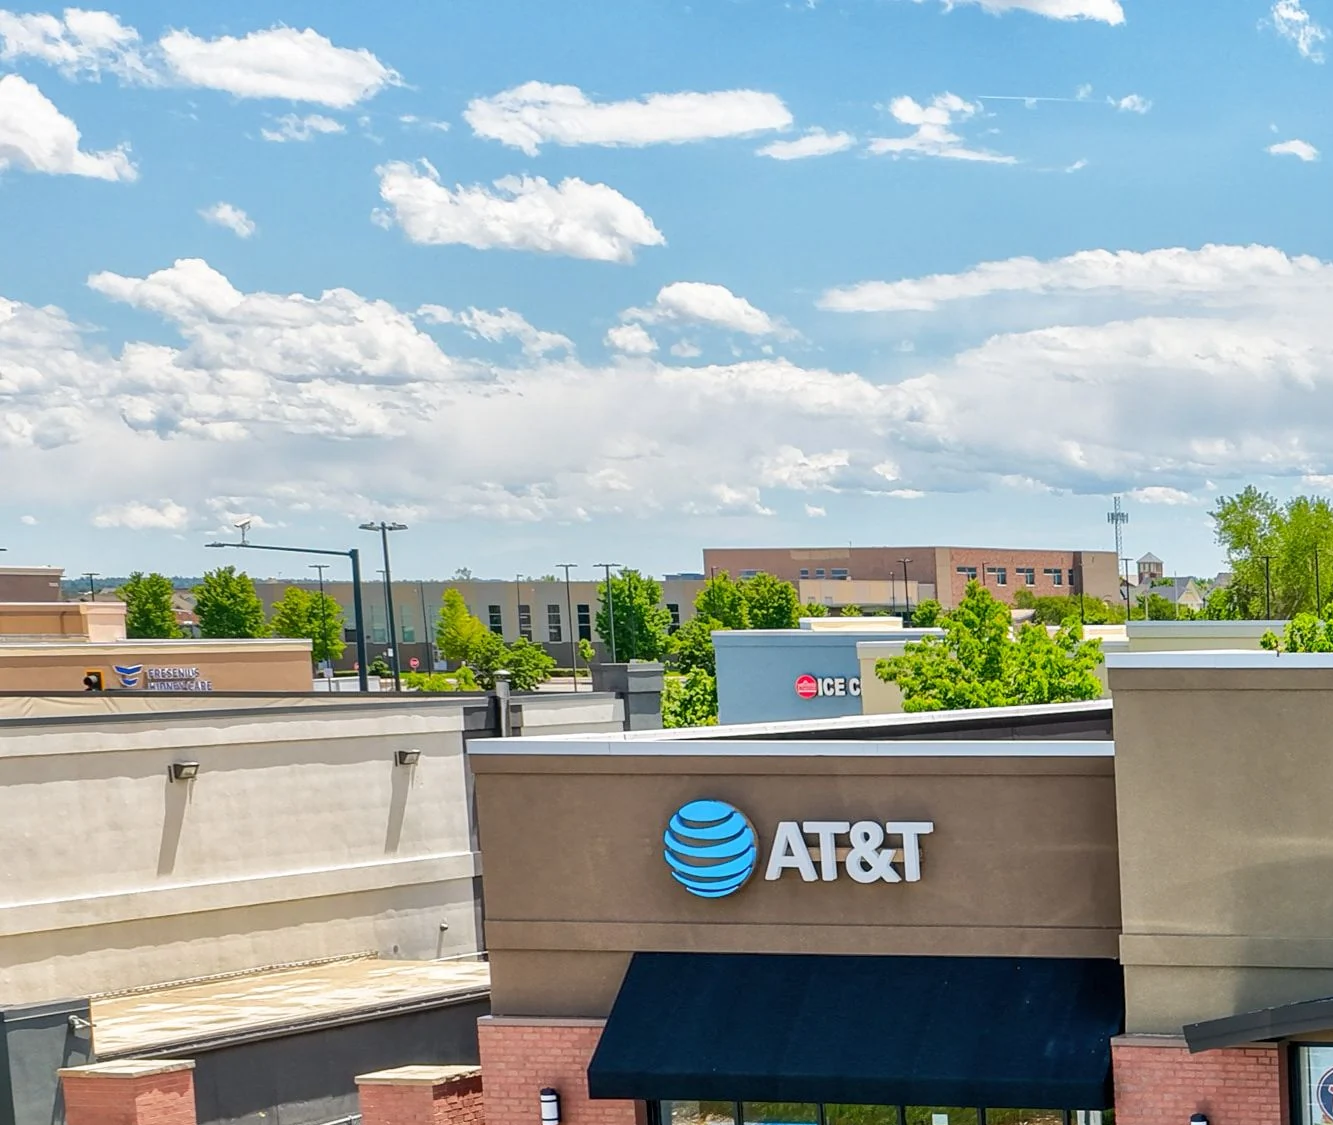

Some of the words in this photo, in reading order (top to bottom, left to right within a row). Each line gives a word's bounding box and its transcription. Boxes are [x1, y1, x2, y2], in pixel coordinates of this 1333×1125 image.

[148, 668, 200, 678] FRESENIUS
[188, 681, 213, 691] CARE
[818, 678, 846, 696] ICE
[848, 678, 863, 696] C
[765, 821, 934, 884] AT&T
